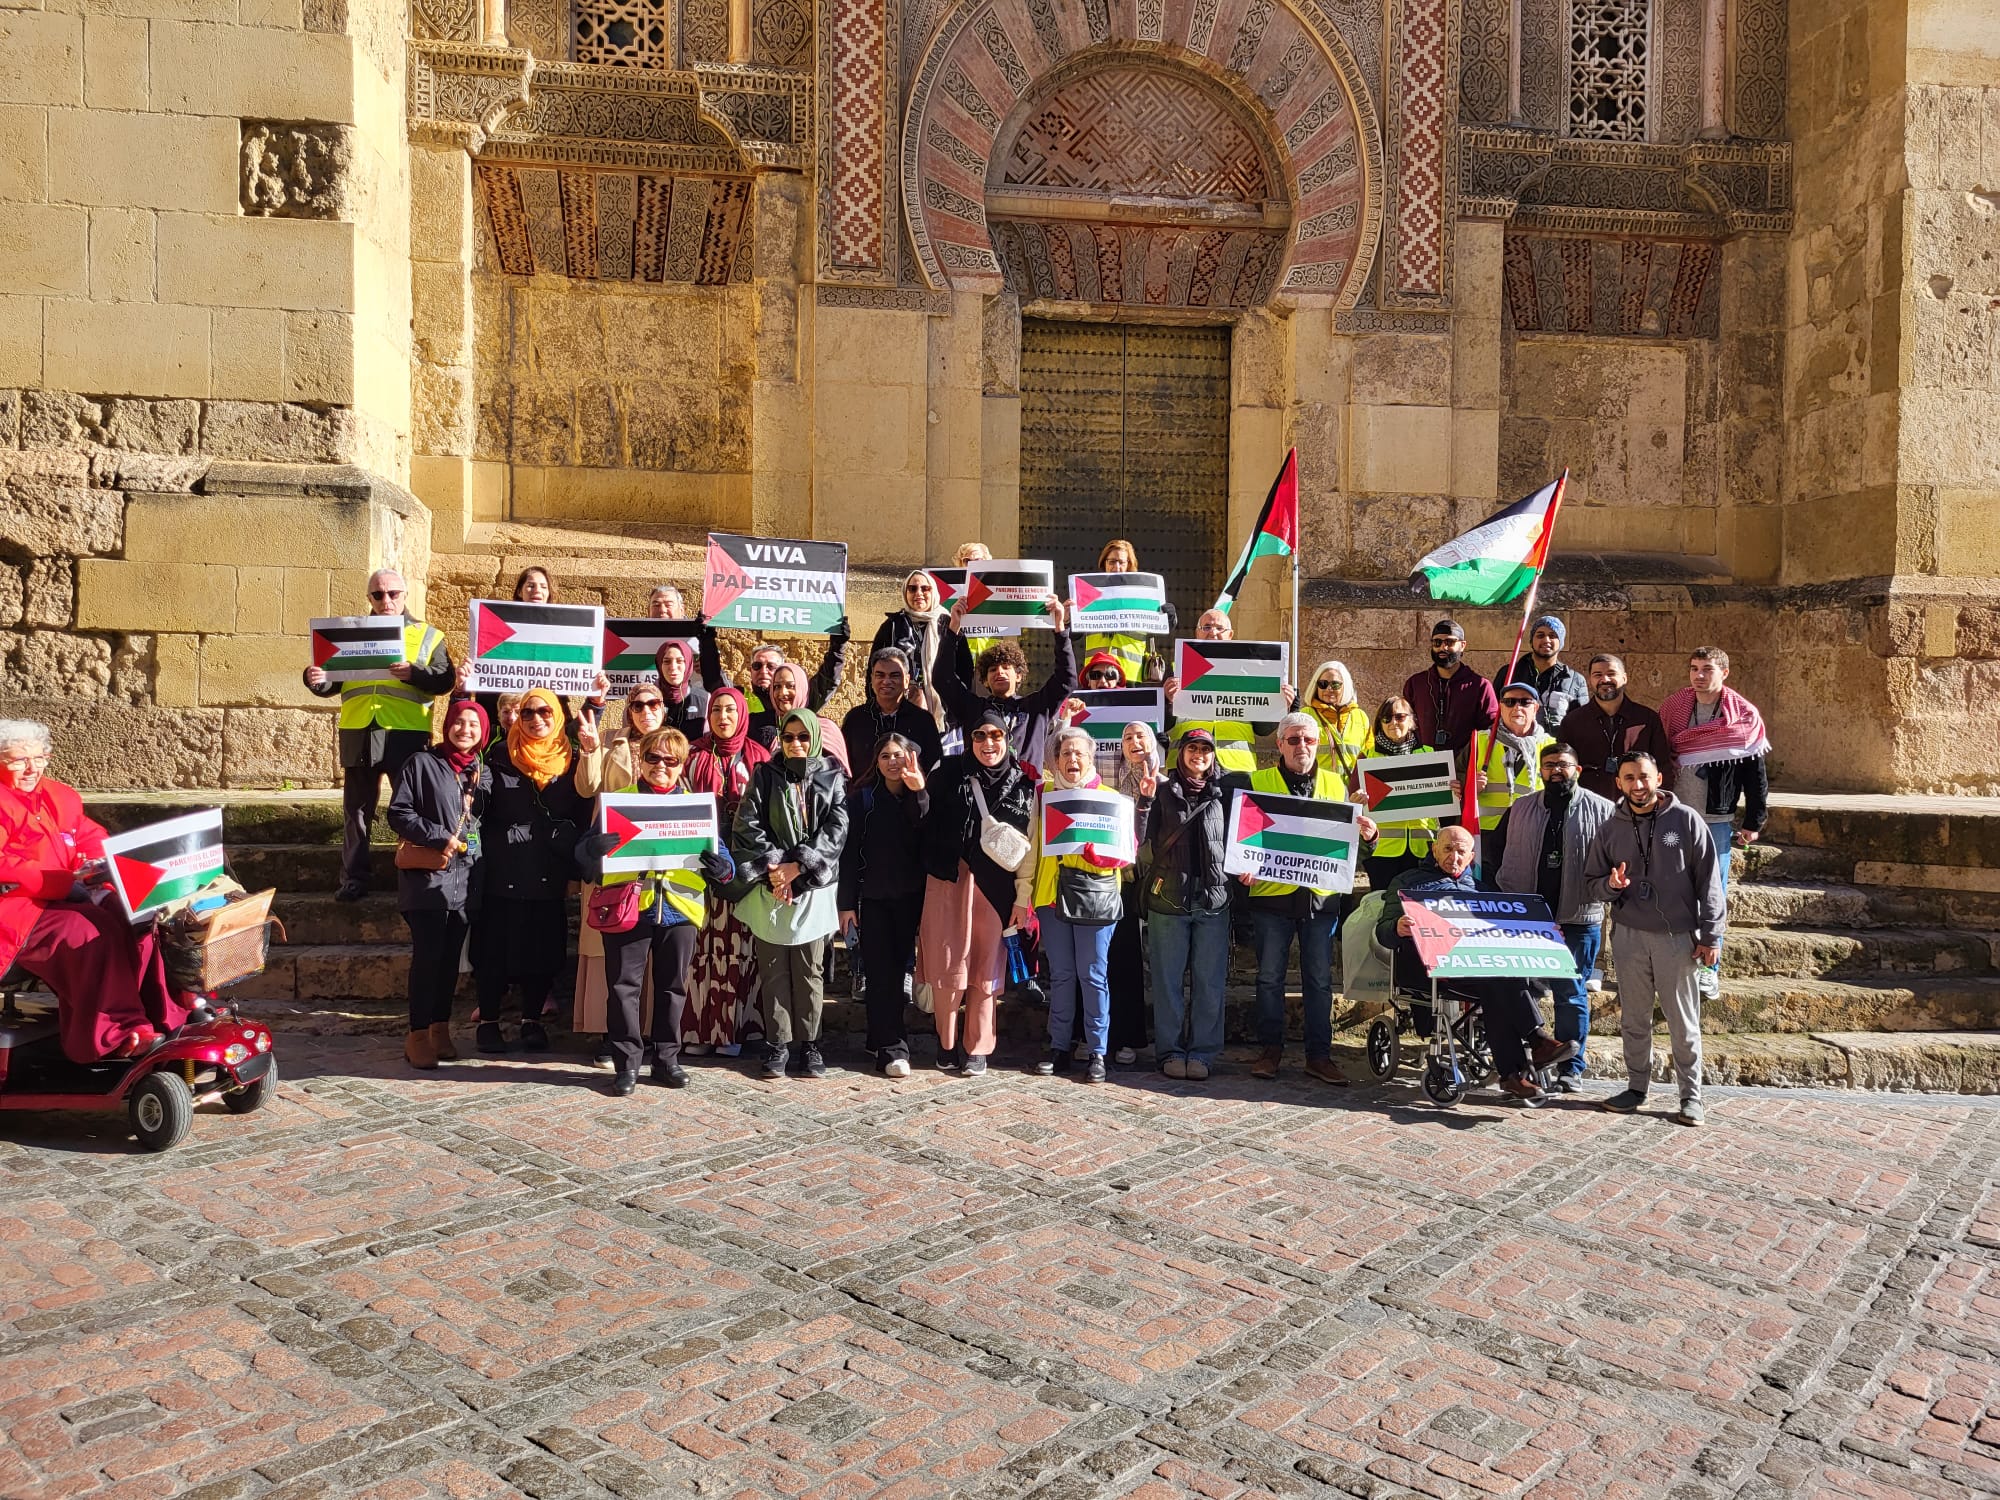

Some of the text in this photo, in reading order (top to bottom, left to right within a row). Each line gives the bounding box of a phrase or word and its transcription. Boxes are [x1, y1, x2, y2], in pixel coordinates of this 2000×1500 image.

[744, 543, 807, 564] VIVA
[712, 573, 837, 595] PALESTINA
[735, 604, 812, 625] LIBRE
[474, 663, 596, 679] SOLIDARIDAD CON EL
[478, 676, 590, 692] PUEBLO PALESTINO
[1191, 694, 1270, 706] VIVA PALESTINA
[1216, 708, 1244, 718] LIBRE
[1406, 782, 1434, 790] PALESTINA
[1434, 780, 1448, 788] LIBRE
[644, 822, 672, 830] PAREMOS
[1243, 849, 1338, 874] STOP OCUPACIÓN
[1258, 866, 1319, 884] PALESTINA
[1423, 898, 1528, 914] PAREMOS
[1419, 927, 1555, 941] EL GENOCIDIO
[1435, 954, 1561, 970] PALESTINO
